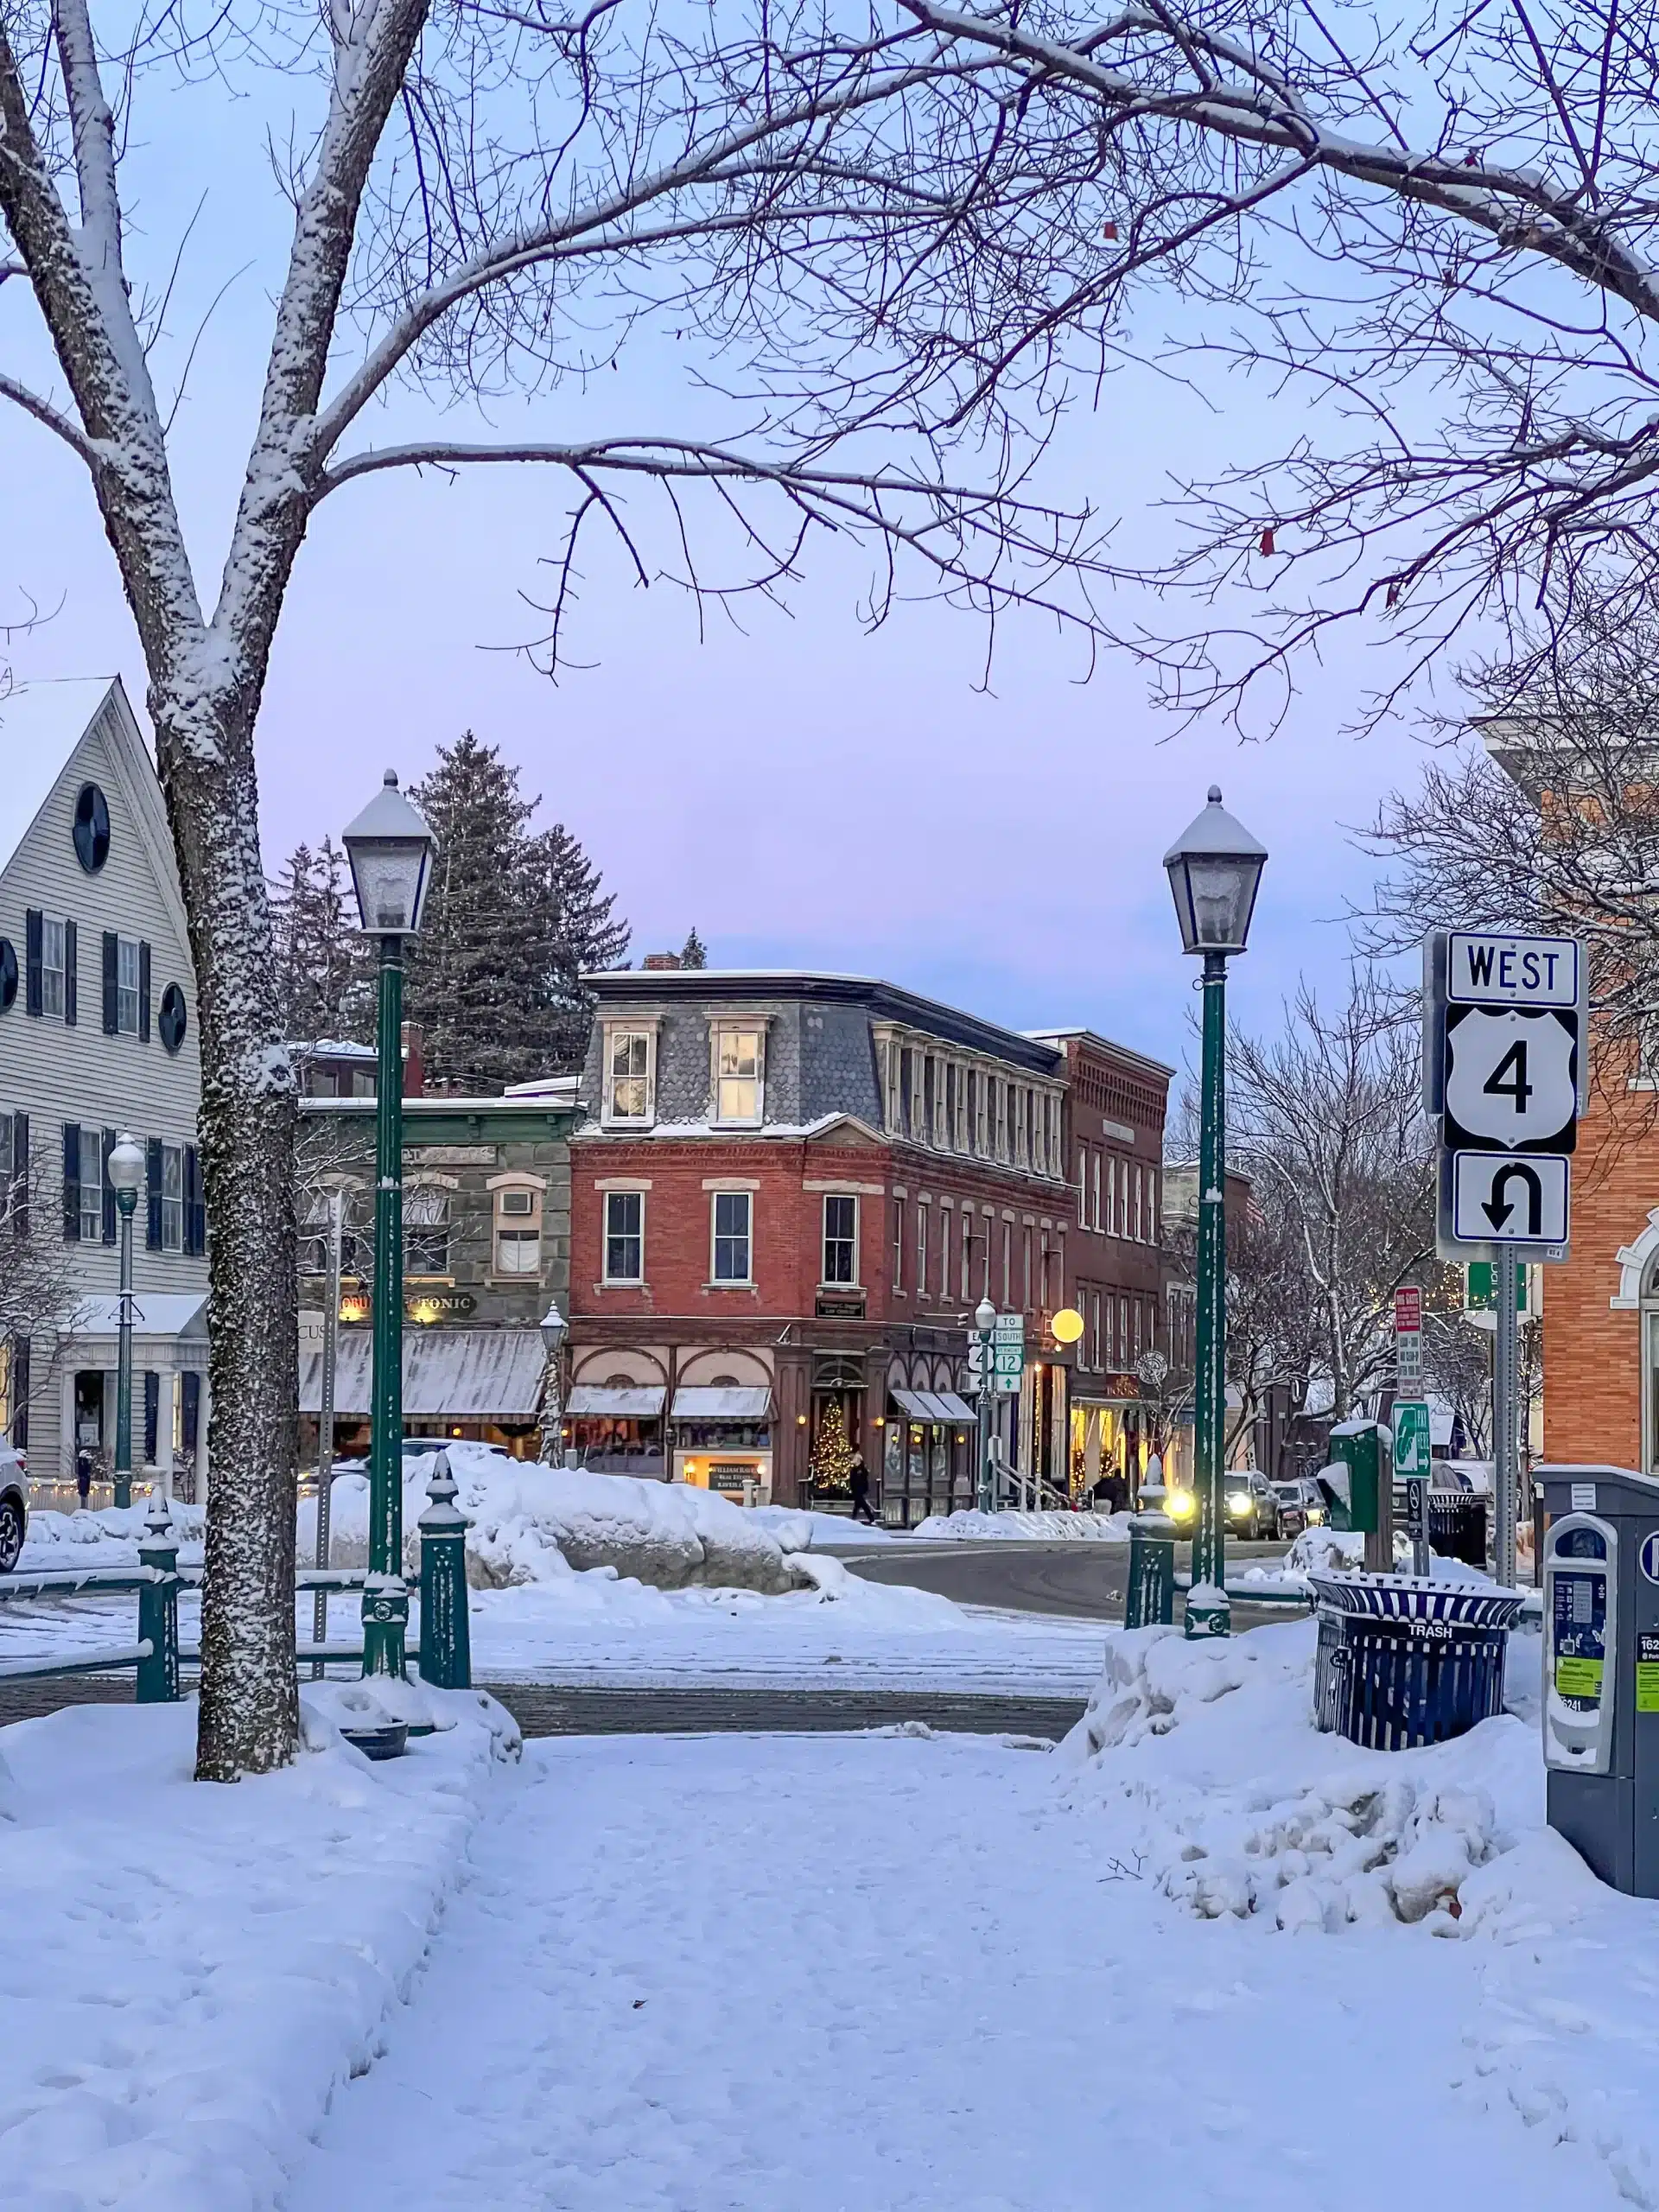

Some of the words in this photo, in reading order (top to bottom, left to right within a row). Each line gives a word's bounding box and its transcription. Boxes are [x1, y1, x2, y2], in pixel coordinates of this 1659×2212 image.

[1467, 944, 1560, 990] WEST
[1483, 1039, 1533, 1114] 4
[421, 1298, 470, 1309] TONIC
[997, 1332, 1020, 1341] SOUTH
[1002, 1356, 1015, 1371] 12
[1417, 1409, 1427, 1428] PAY
[1417, 1431, 1429, 1450] HERE
[1408, 1624, 1452, 1639] TRASH
